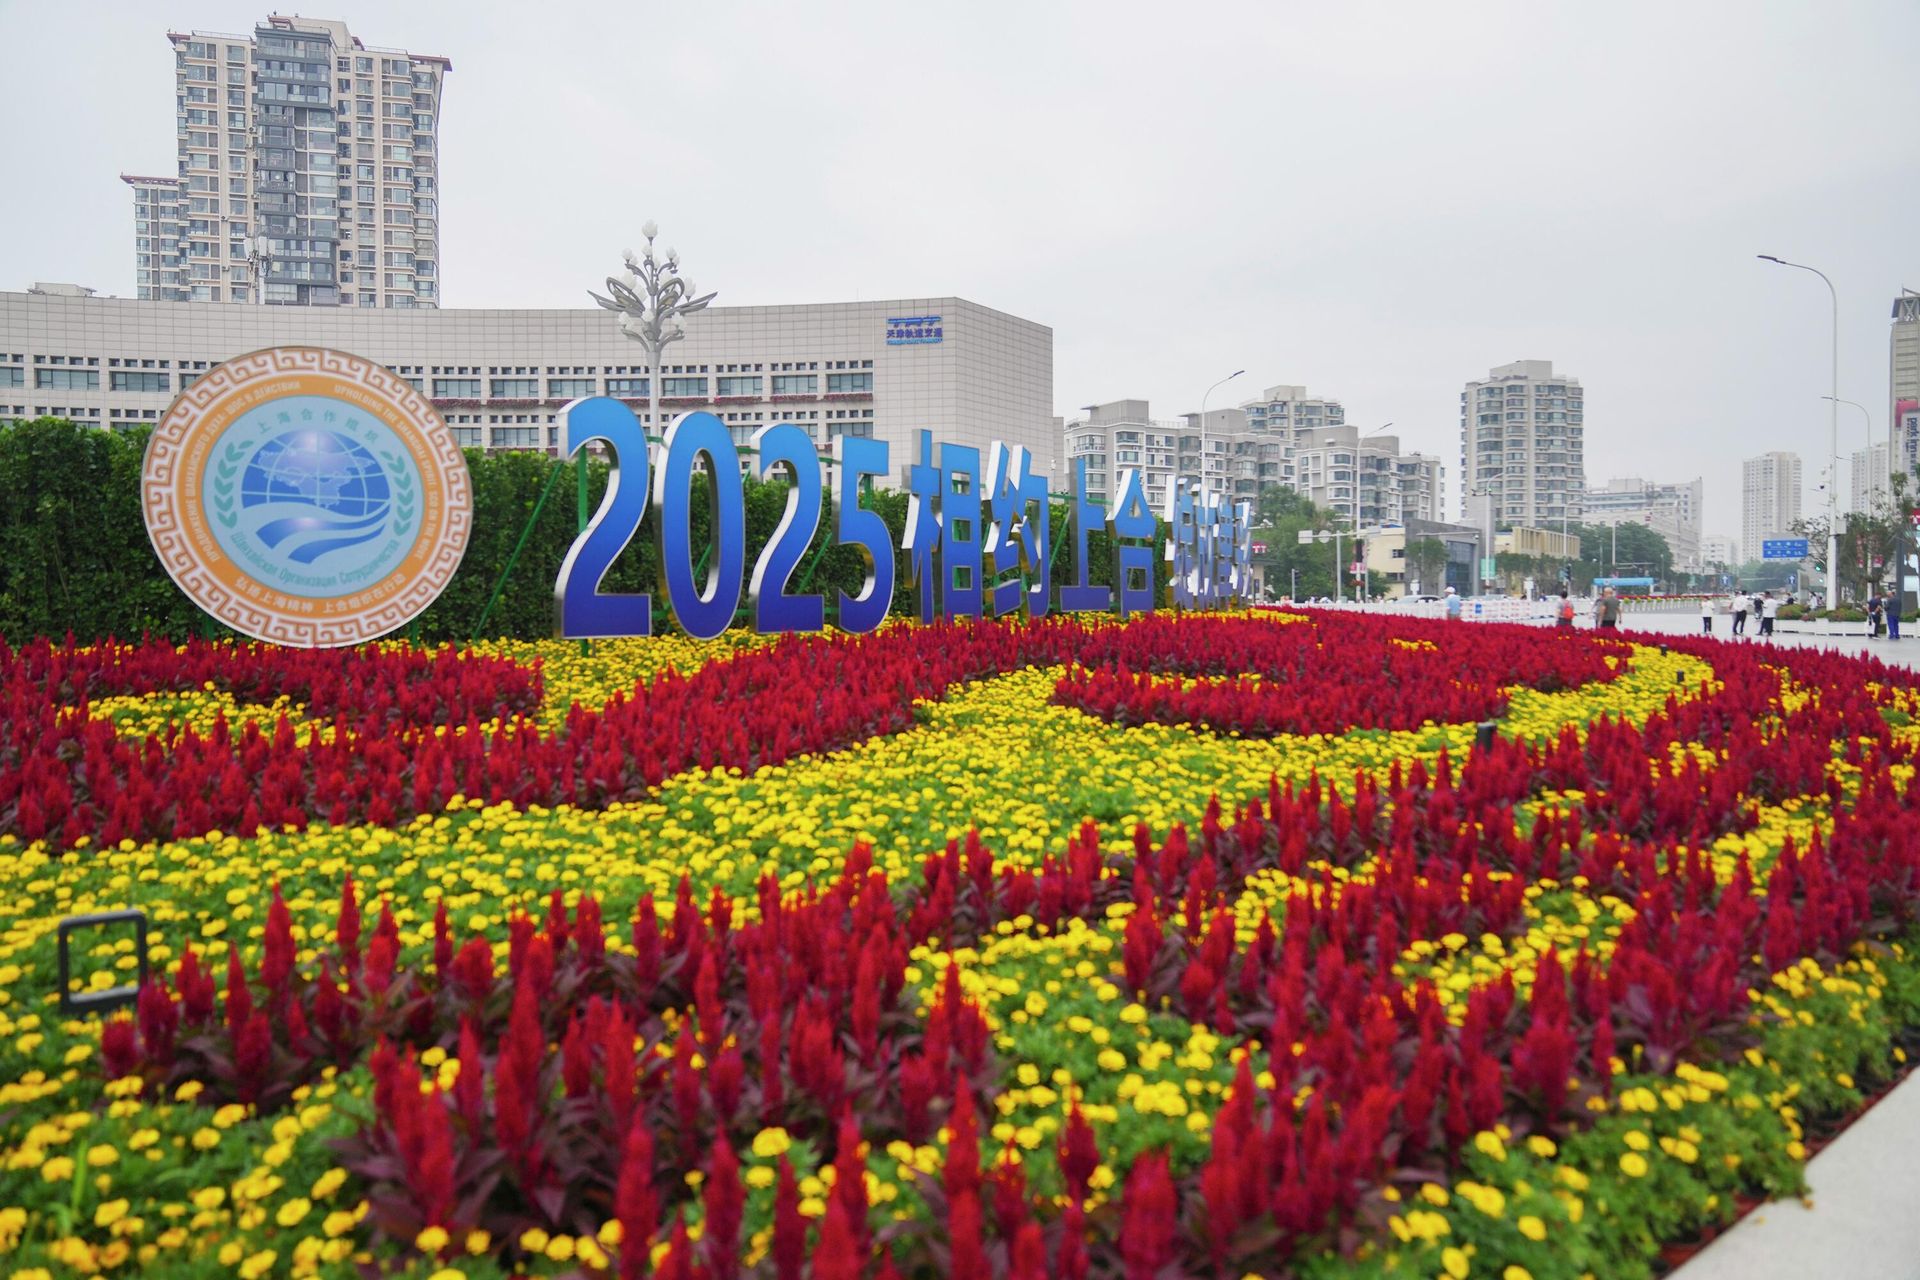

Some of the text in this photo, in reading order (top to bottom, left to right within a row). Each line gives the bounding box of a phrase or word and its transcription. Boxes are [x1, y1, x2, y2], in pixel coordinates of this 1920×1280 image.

[252, 407, 380, 445] 上海合作组织
